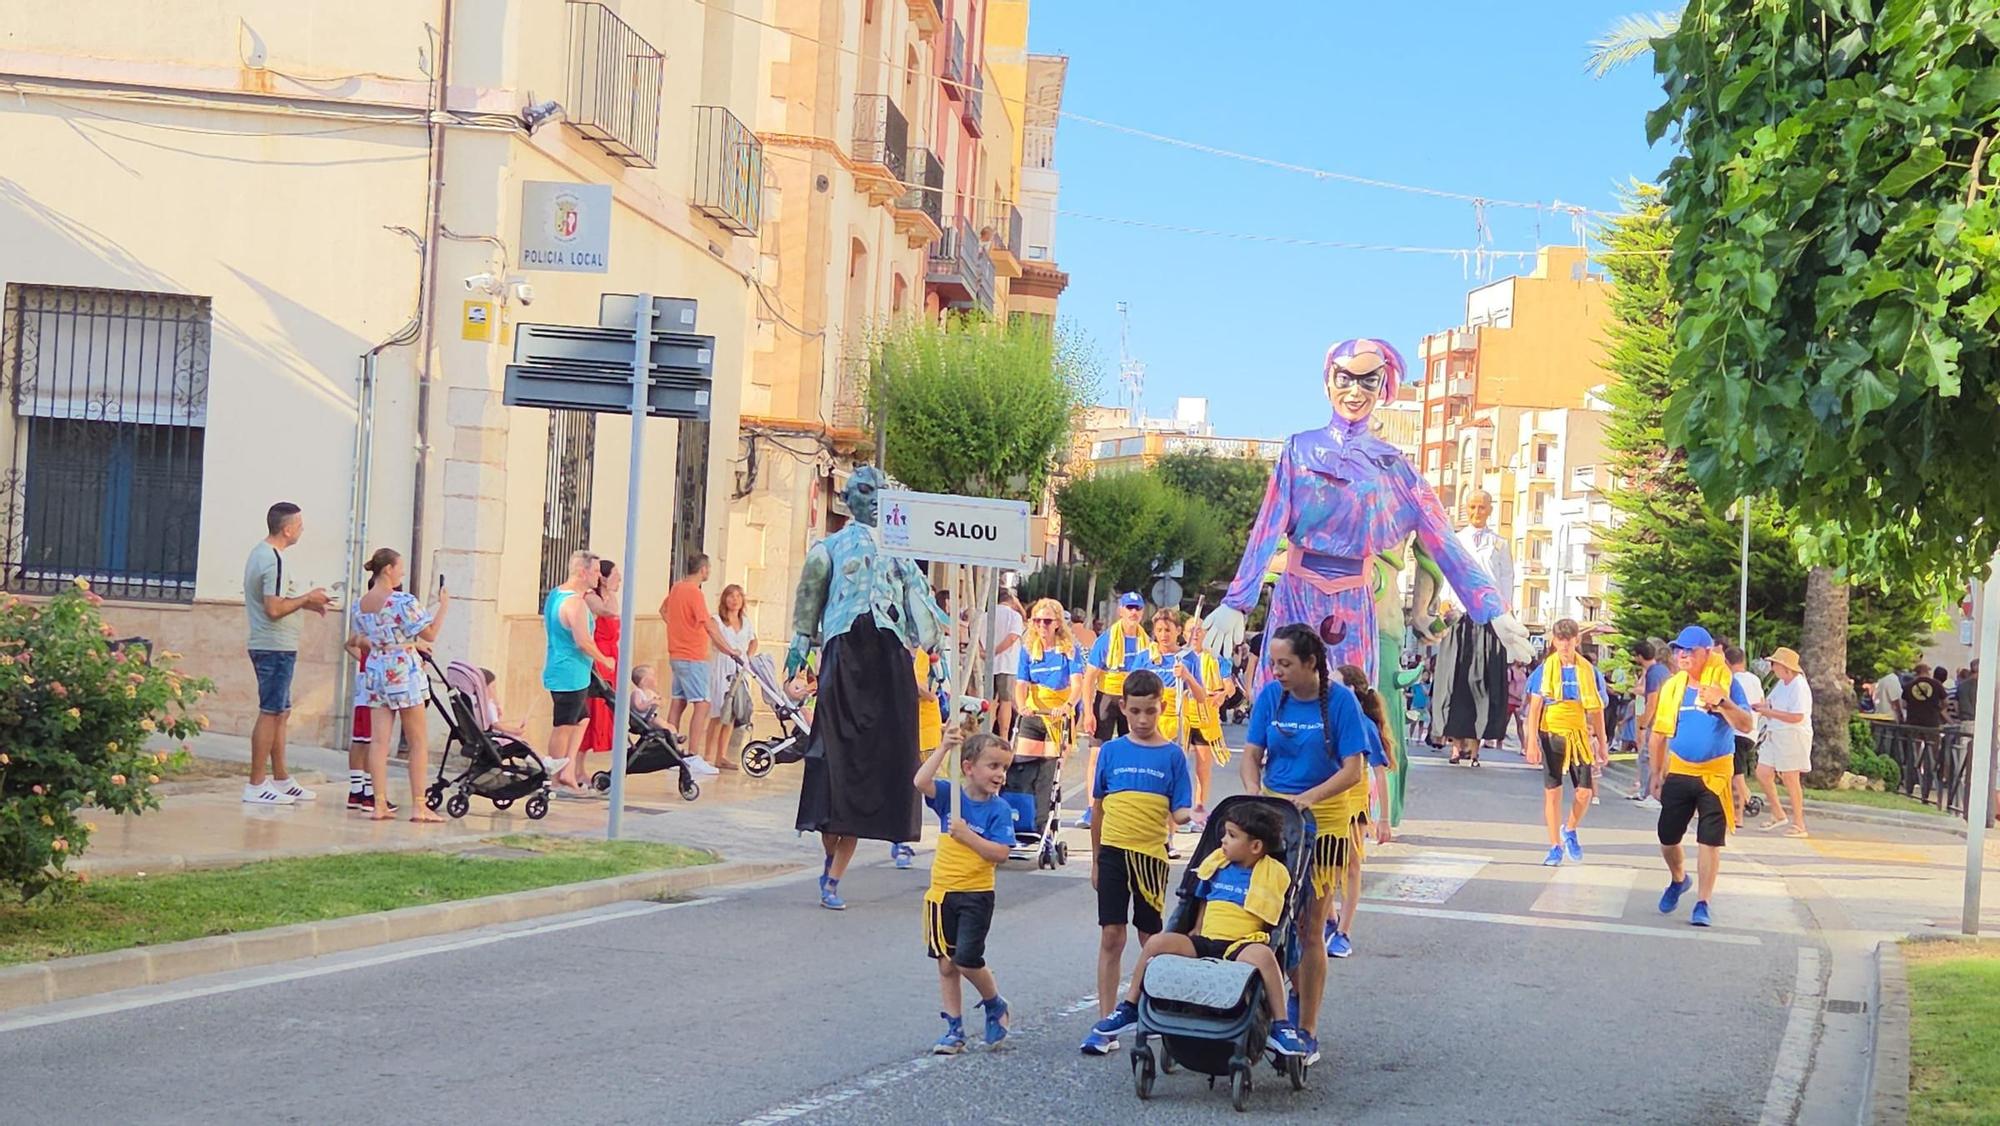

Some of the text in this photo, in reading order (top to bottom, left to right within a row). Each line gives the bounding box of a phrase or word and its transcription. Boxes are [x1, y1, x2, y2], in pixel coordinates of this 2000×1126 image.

[524, 249, 603, 266] POLICIA LOCAL
[934, 521, 997, 541] SALOU
